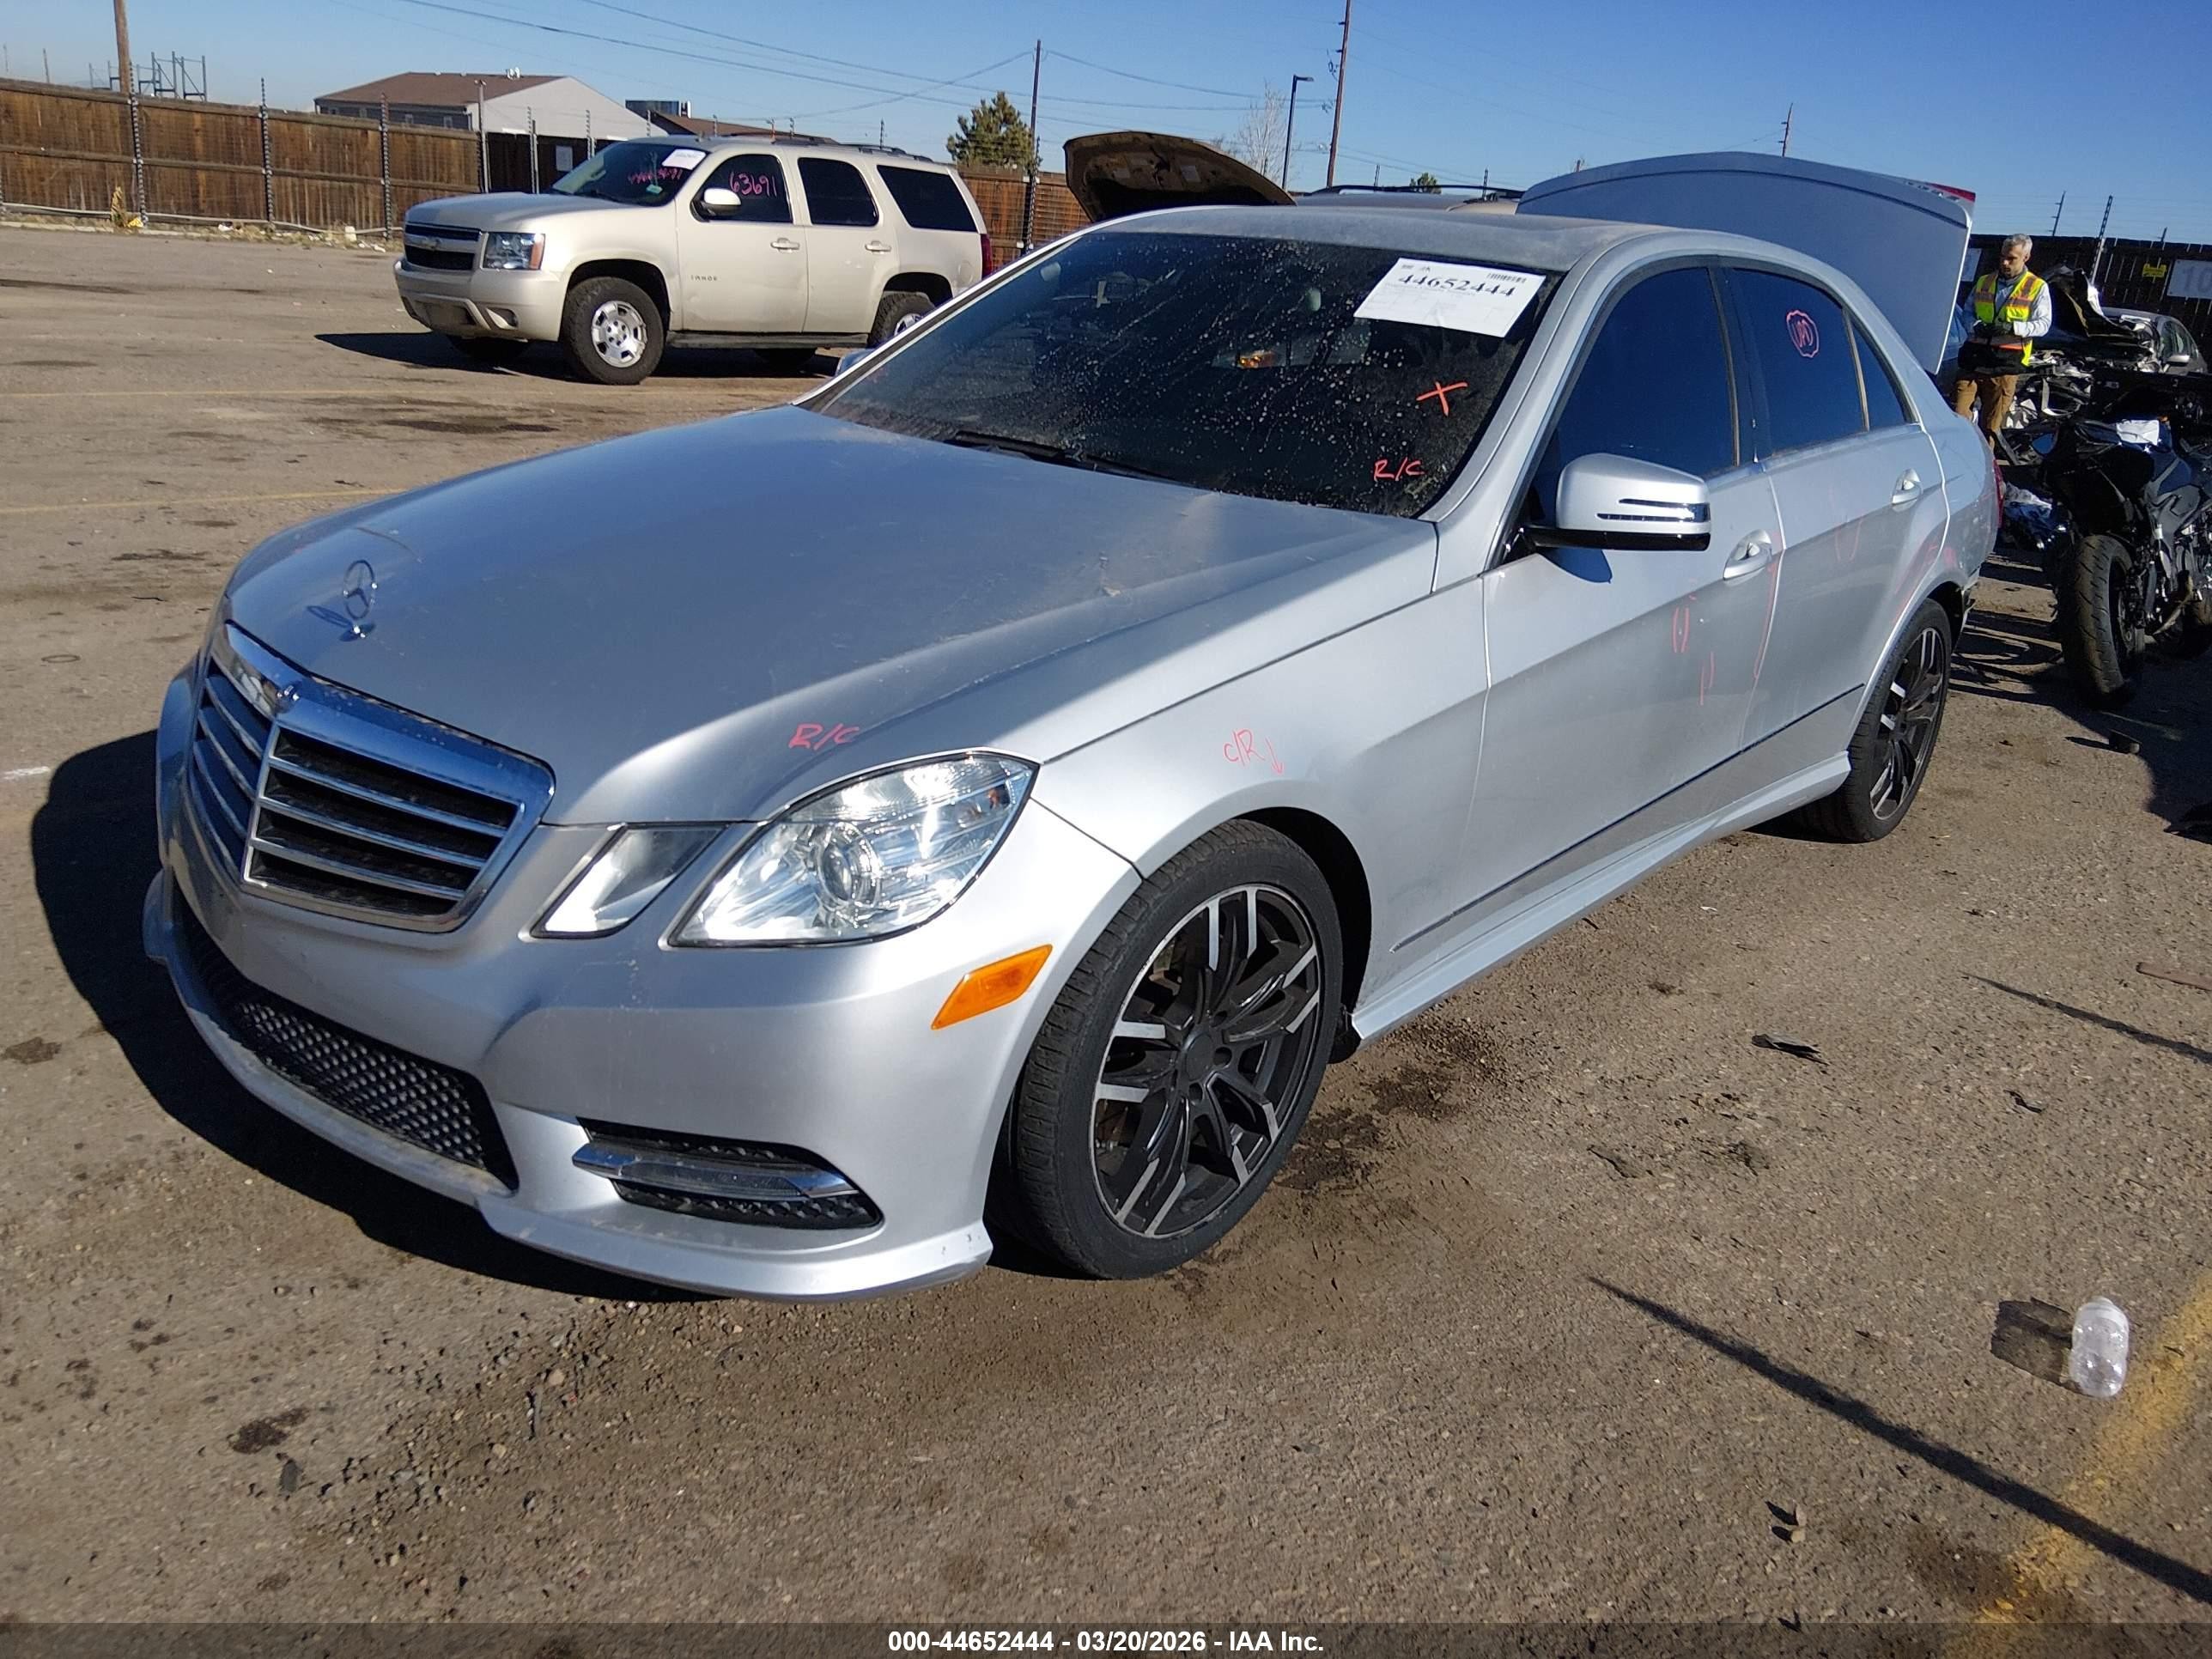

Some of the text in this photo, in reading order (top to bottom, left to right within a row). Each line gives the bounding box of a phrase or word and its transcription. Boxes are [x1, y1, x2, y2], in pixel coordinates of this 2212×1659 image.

[730, 171, 777, 197] 63691
[1399, 274, 1516, 297] 44652444
[1374, 457, 1425, 482] R/C
[788, 722, 860, 750] R/C
